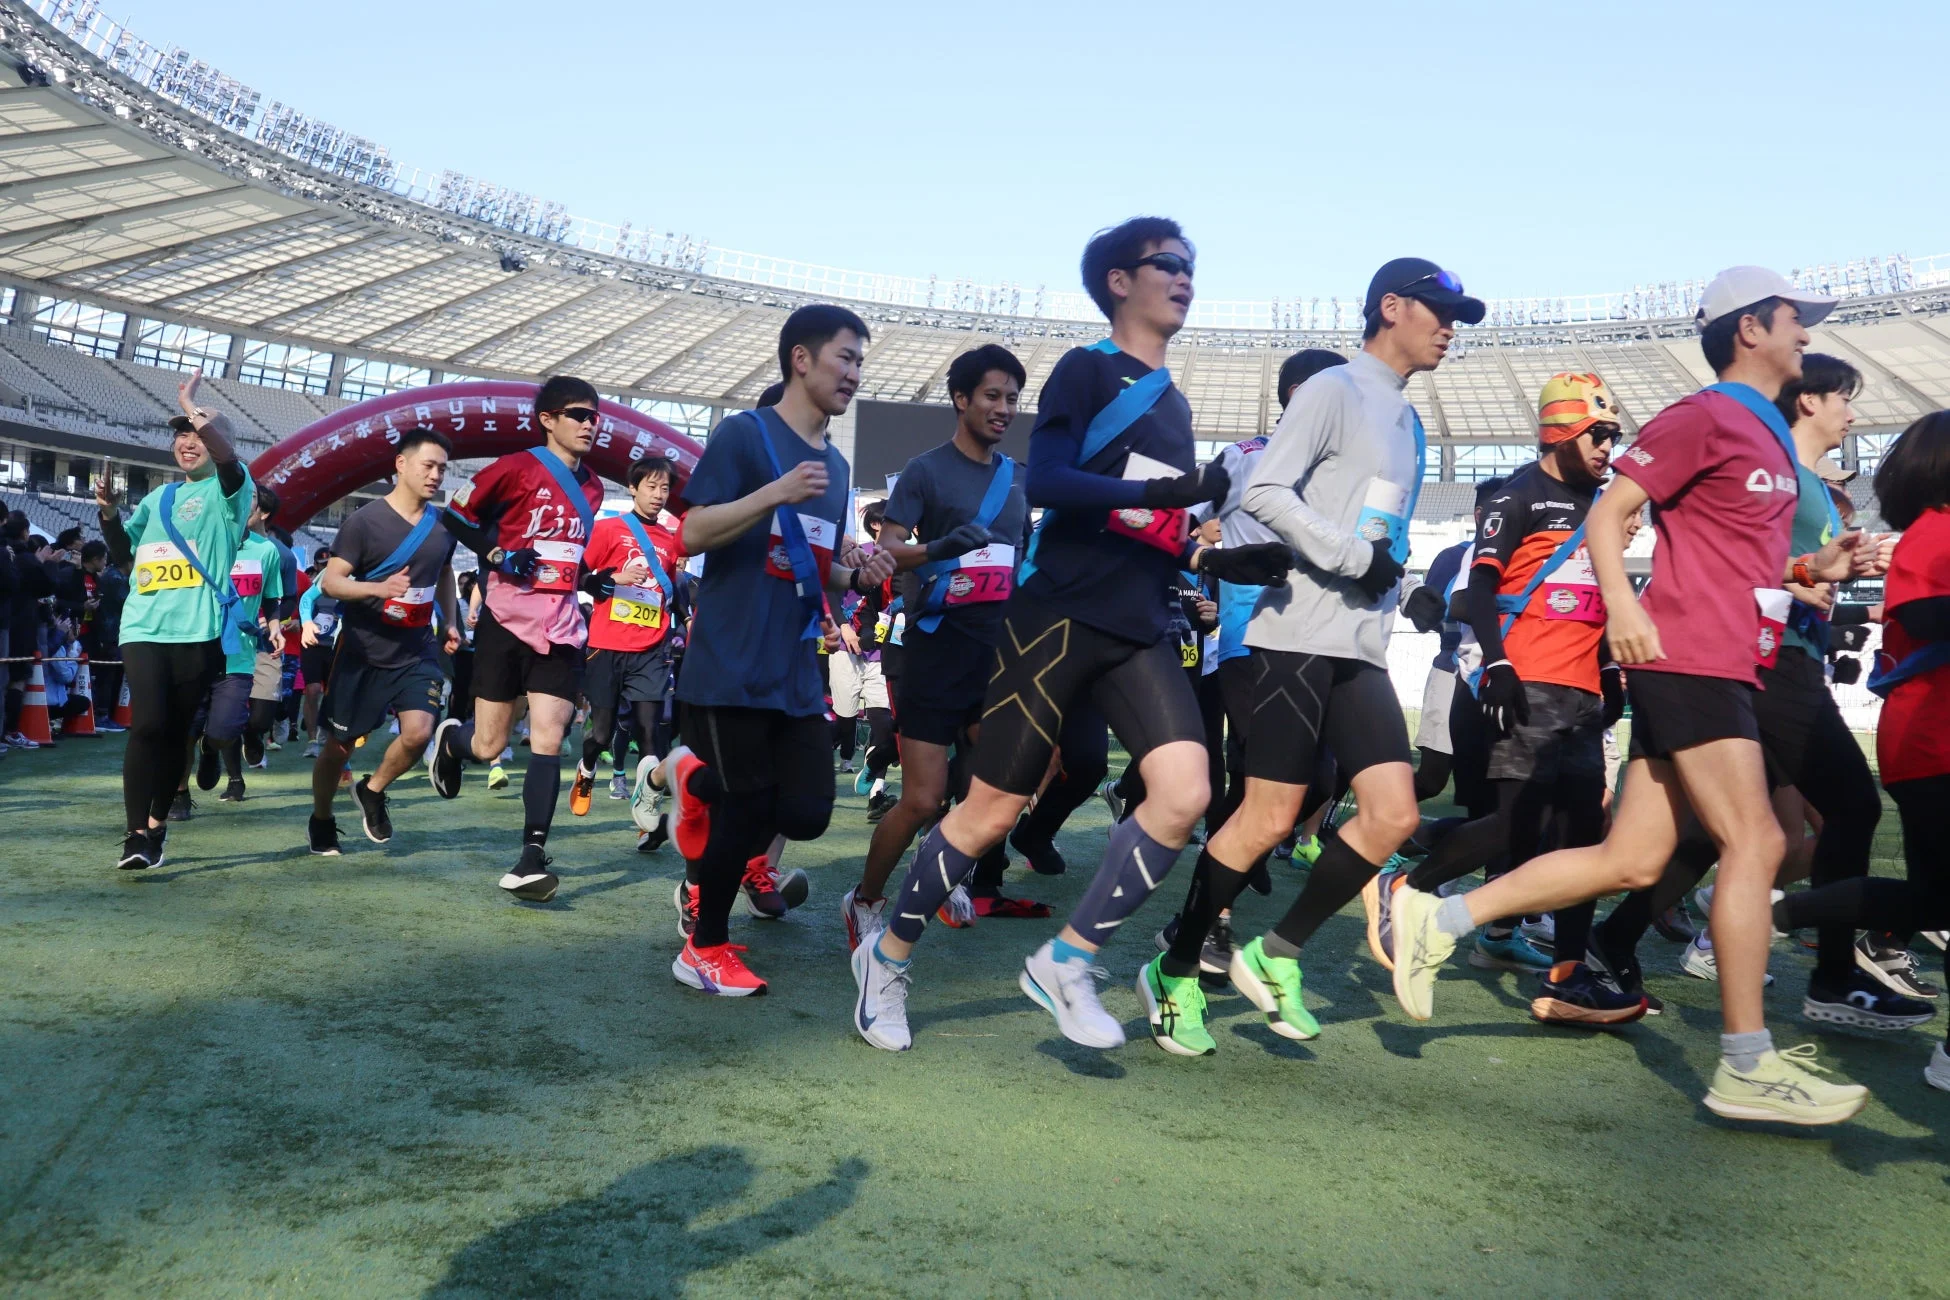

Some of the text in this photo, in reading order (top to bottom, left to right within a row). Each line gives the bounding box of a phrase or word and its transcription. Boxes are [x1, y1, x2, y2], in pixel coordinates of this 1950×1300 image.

[415, 399, 497, 420] RUN
[521, 504, 586, 538] Lio
[156, 564, 194, 582] 201
[633, 605, 658, 622] 207
